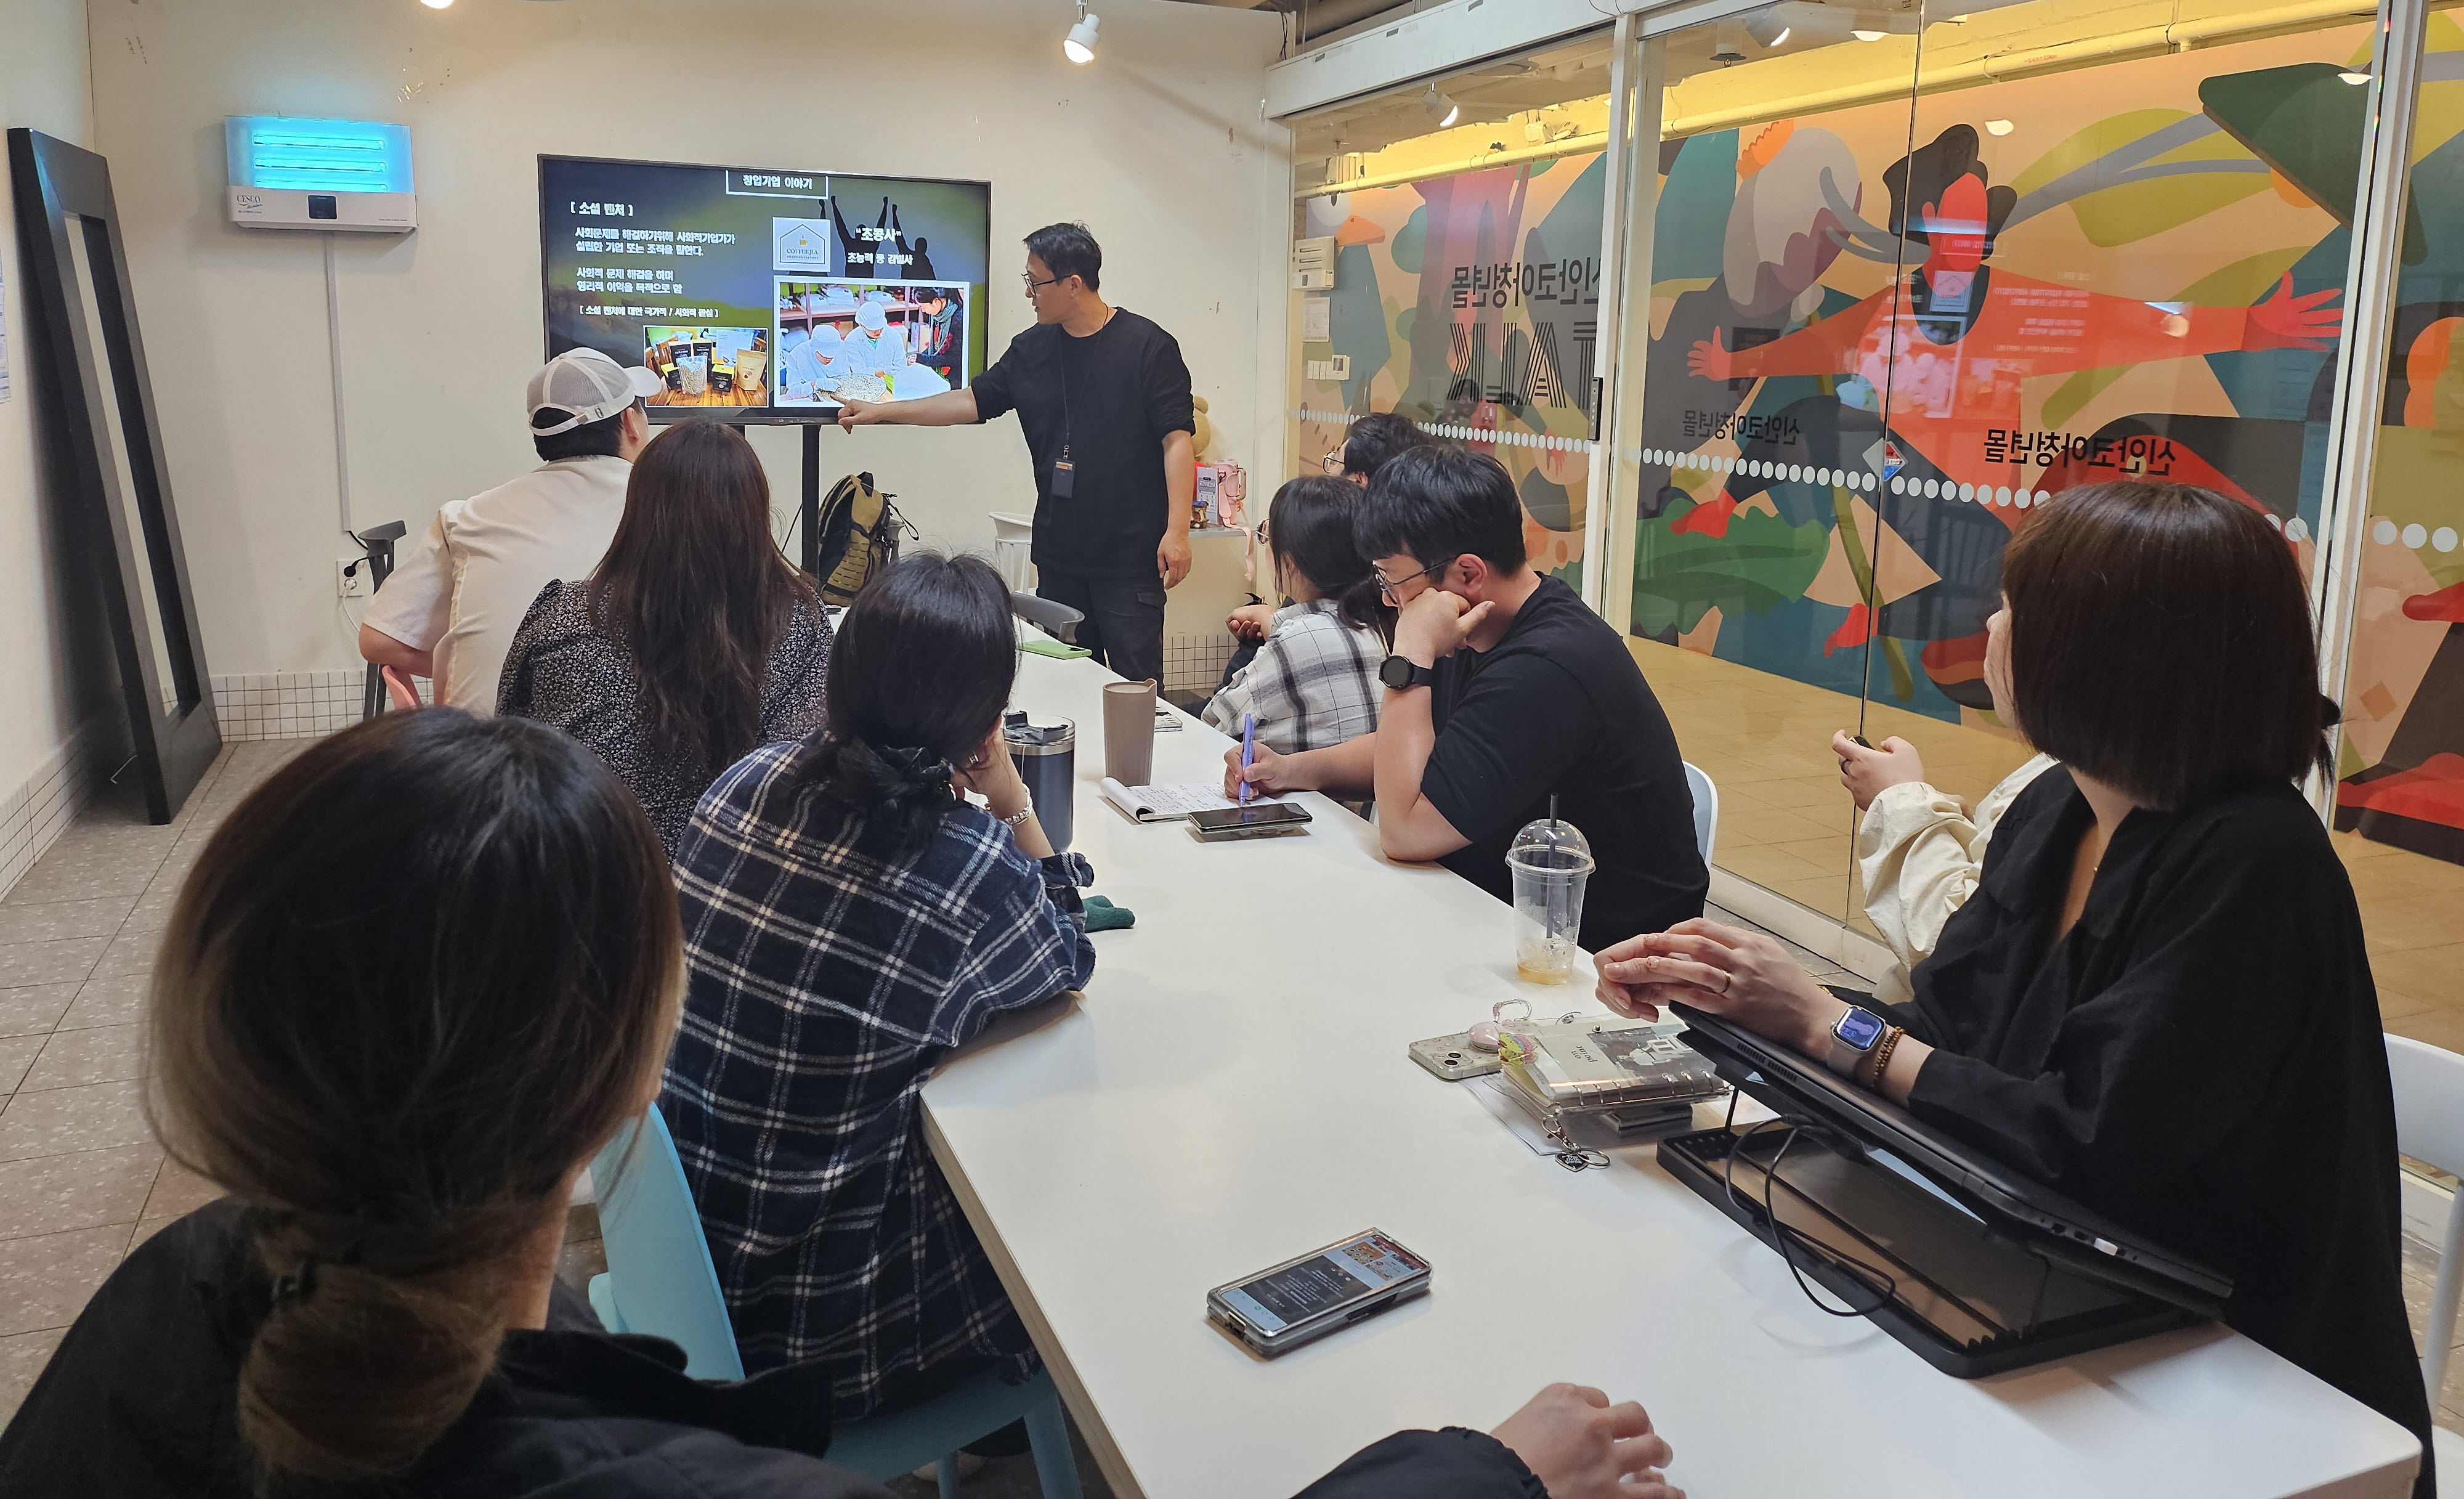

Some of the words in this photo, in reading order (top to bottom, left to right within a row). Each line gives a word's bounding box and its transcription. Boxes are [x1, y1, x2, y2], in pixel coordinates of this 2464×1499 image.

[742, 174, 780, 188] 창업기업
[784, 177, 813, 190] 이야기
[237, 195, 260, 203] CESCO
[579, 202, 601, 215] 소셜
[604, 203, 625, 216] 벤처
[575, 227, 620, 240] 사회문제를
[622, 229, 674, 242] 해결하기위해
[676, 231, 736, 245] 사회적기업가가
[575, 240, 604, 253] 설립한
[605, 242, 624, 253] 기업
[626, 243, 645, 254] 또는
[647, 243, 673, 255] 조직을
[676, 244, 704, 256] 말한다.
[847, 251, 873, 264] 초능력
[875, 253, 885, 264] 콩
[887, 254, 914, 266] 감별사
[576, 267, 604, 278] 사회적
[606, 268, 625, 279] 문제
[626, 269, 653, 280] 해결을
[655, 269, 674, 281] 하며
[577, 280, 604, 292] 영리적
[607, 282, 633, 293] 이익을
[636, 282, 670, 294] 목적으로
[673, 283, 683, 295] 함
[585, 306, 601, 315] 소셜
[603, 306, 626, 316] 벤처에
[627, 307, 643, 317] 대한
[644, 307, 667, 317] 국가적
[675, 307, 697, 317] 사회적
[1576, 1046, 1598, 1062] point
